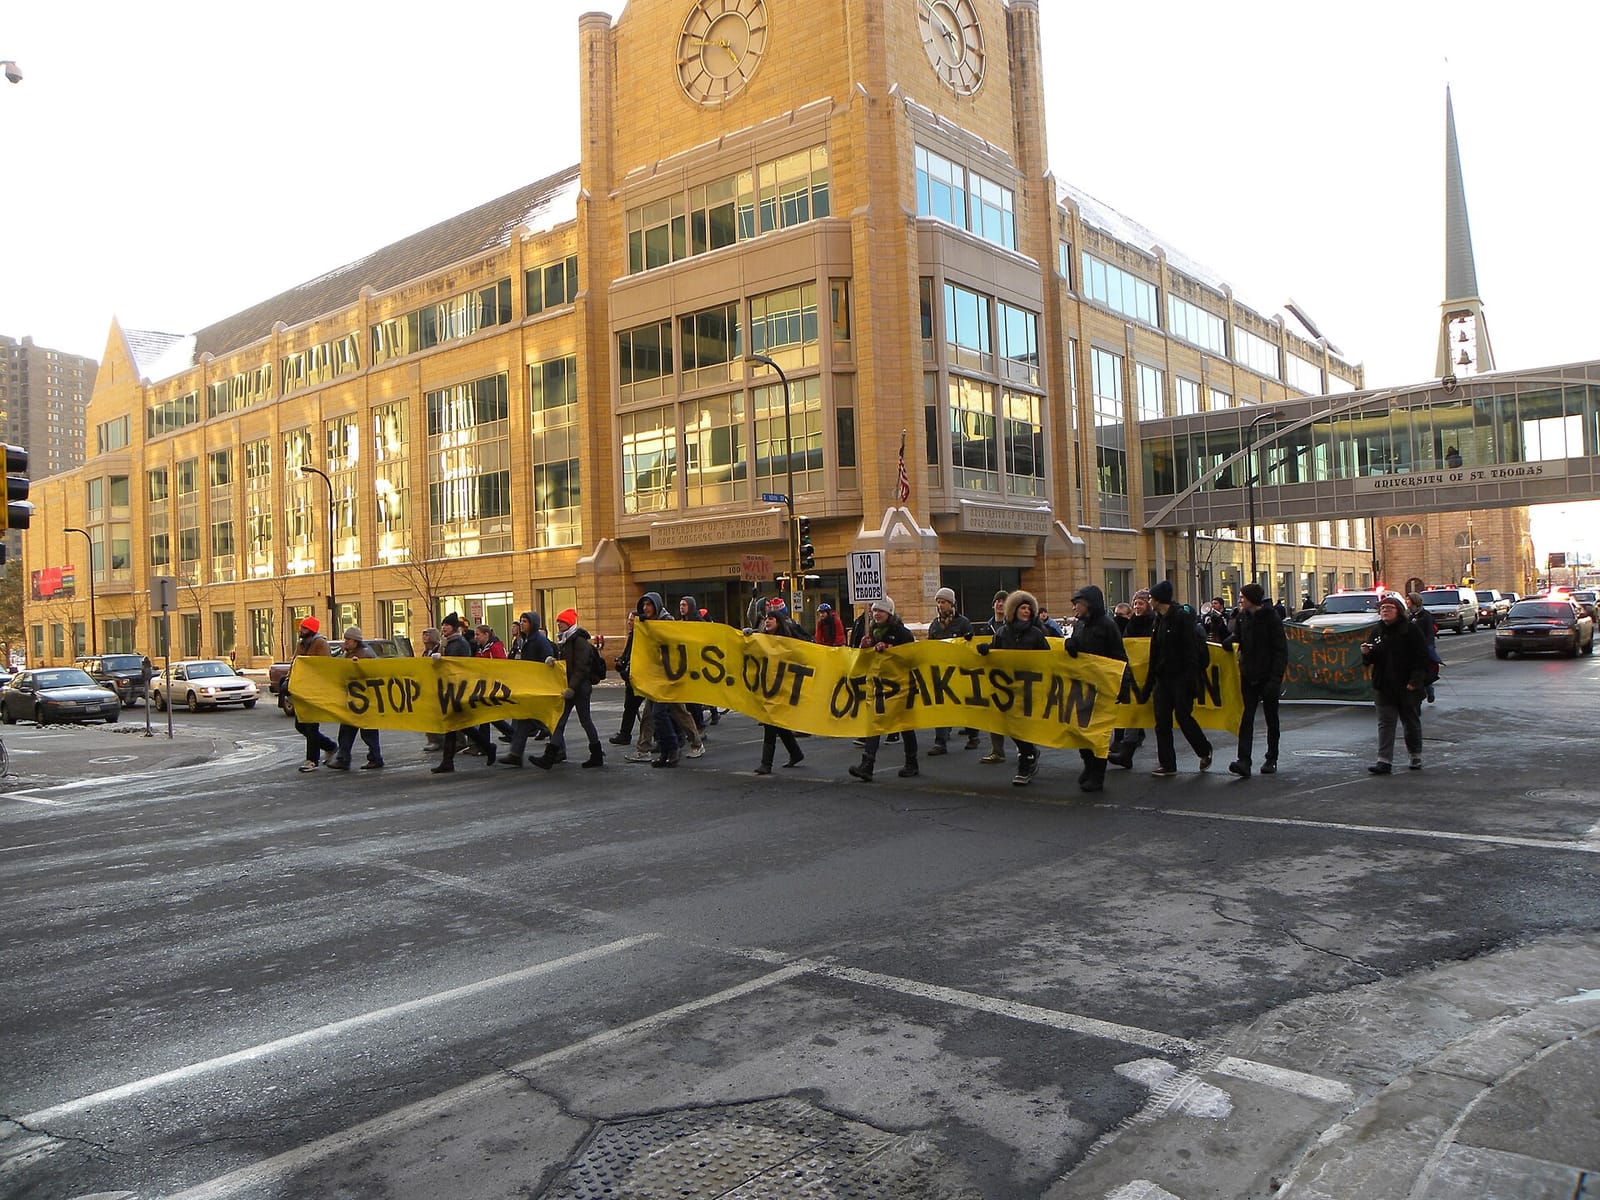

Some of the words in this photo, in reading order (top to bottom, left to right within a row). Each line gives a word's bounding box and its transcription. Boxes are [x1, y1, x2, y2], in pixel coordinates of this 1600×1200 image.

[1374, 475, 1443, 489] UNIVERSITY
[1449, 473, 1463, 482] OF
[1491, 465, 1543, 478] THOMAS
[743, 560, 769, 573] WAR
[860, 554, 872, 569] NO
[856, 571, 879, 585] MORE
[856, 586, 881, 598] TROOPS
[1311, 647, 1349, 668] NOT
[660, 644, 735, 687] U.S.
[743, 654, 815, 706] OUT
[830, 675, 867, 719] OF
[873, 664, 1098, 728] PAKISTAN
[347, 678, 421, 715] STOP
[437, 677, 519, 715] WAR
